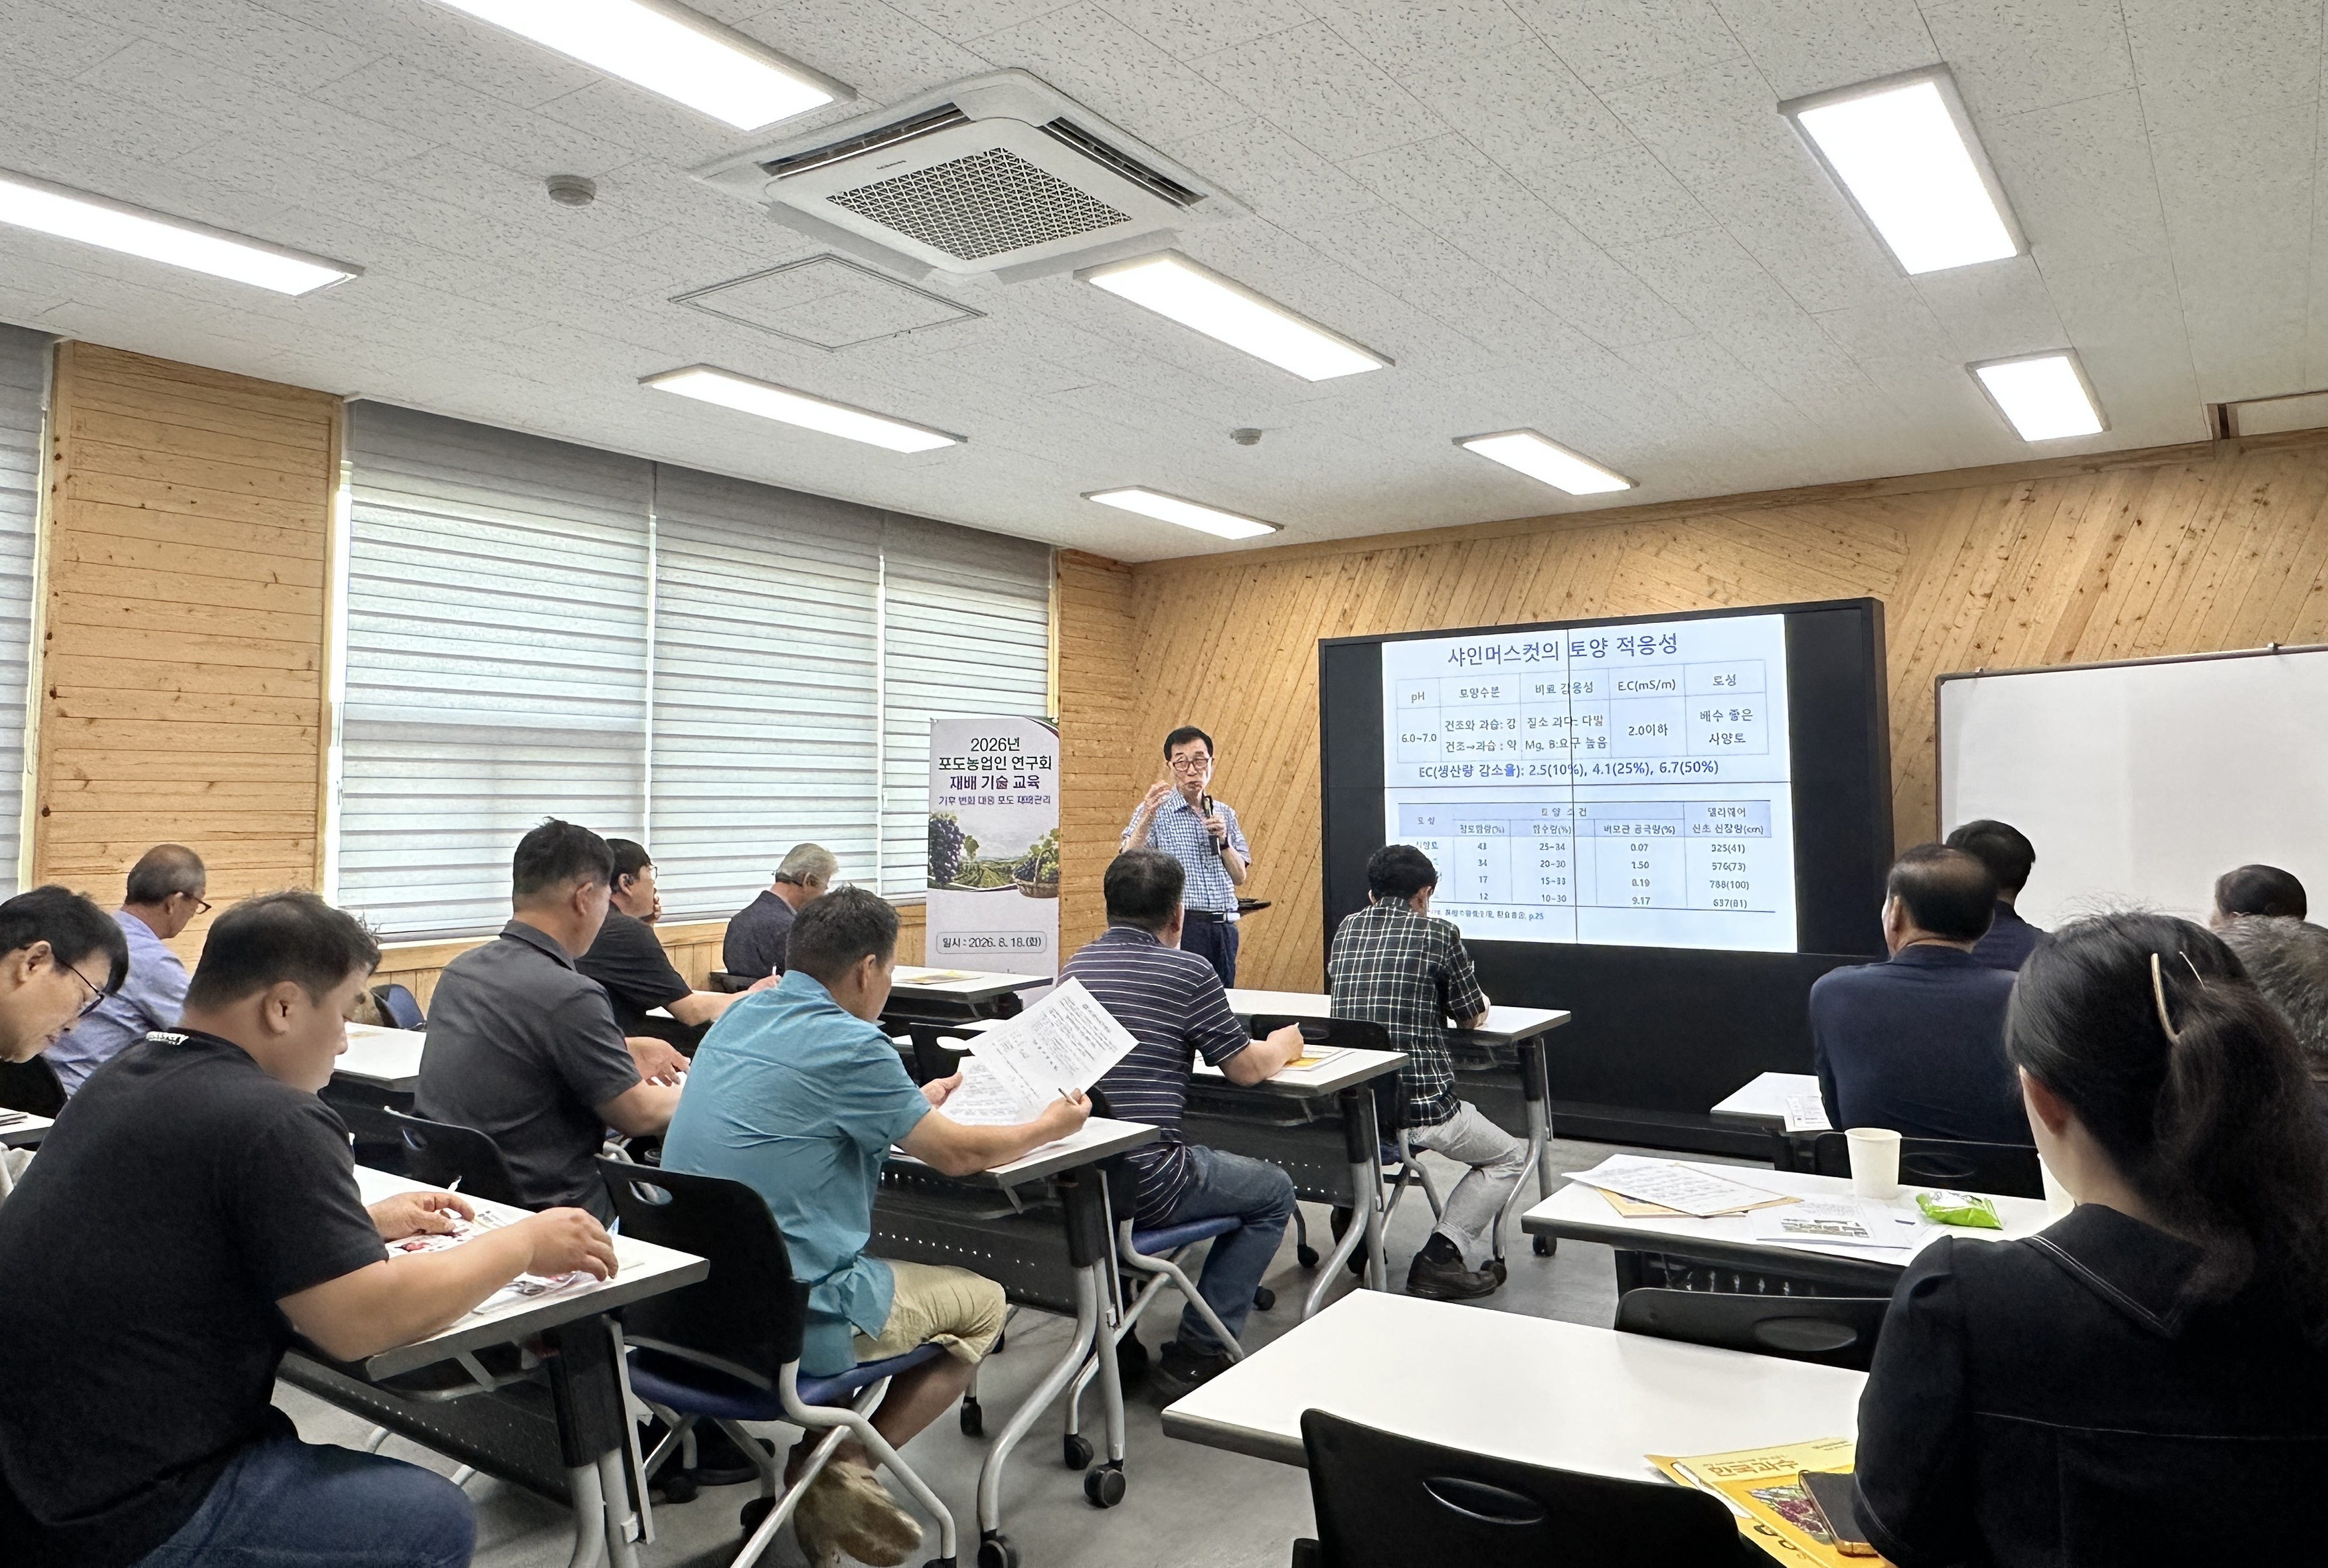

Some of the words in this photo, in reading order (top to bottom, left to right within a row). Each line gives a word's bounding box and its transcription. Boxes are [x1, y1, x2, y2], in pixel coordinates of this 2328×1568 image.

[1448, 641, 1558, 667] 샤인머스컷의
[1570, 637, 1608, 659] 토양
[1617, 633, 1677, 657] 적응성
[1618, 678, 1676, 692] EC(mS/m)
[1411, 692, 1425, 704] pH
[1700, 710, 1724, 722] 배수
[1445, 720, 1475, 732] 건조와
[1628, 724, 1668, 736] 2.0이하
[970, 737, 1021, 752] 2026년
[1402, 734, 1437, 742] 6.0~7.0
[1708, 732, 1746, 745] 사양토
[938, 755, 1007, 771] 포도농업인
[1011, 755, 1052, 771] 연구회
[1592, 762, 1653, 777] 4.1(25%),
[1659, 760, 1719, 775] 6.7(50%)
[950, 775, 977, 790] 재배
[981, 775, 1009, 790] 기술
[1013, 774, 1040, 789] 교육
[939, 796, 956, 806] 기후
